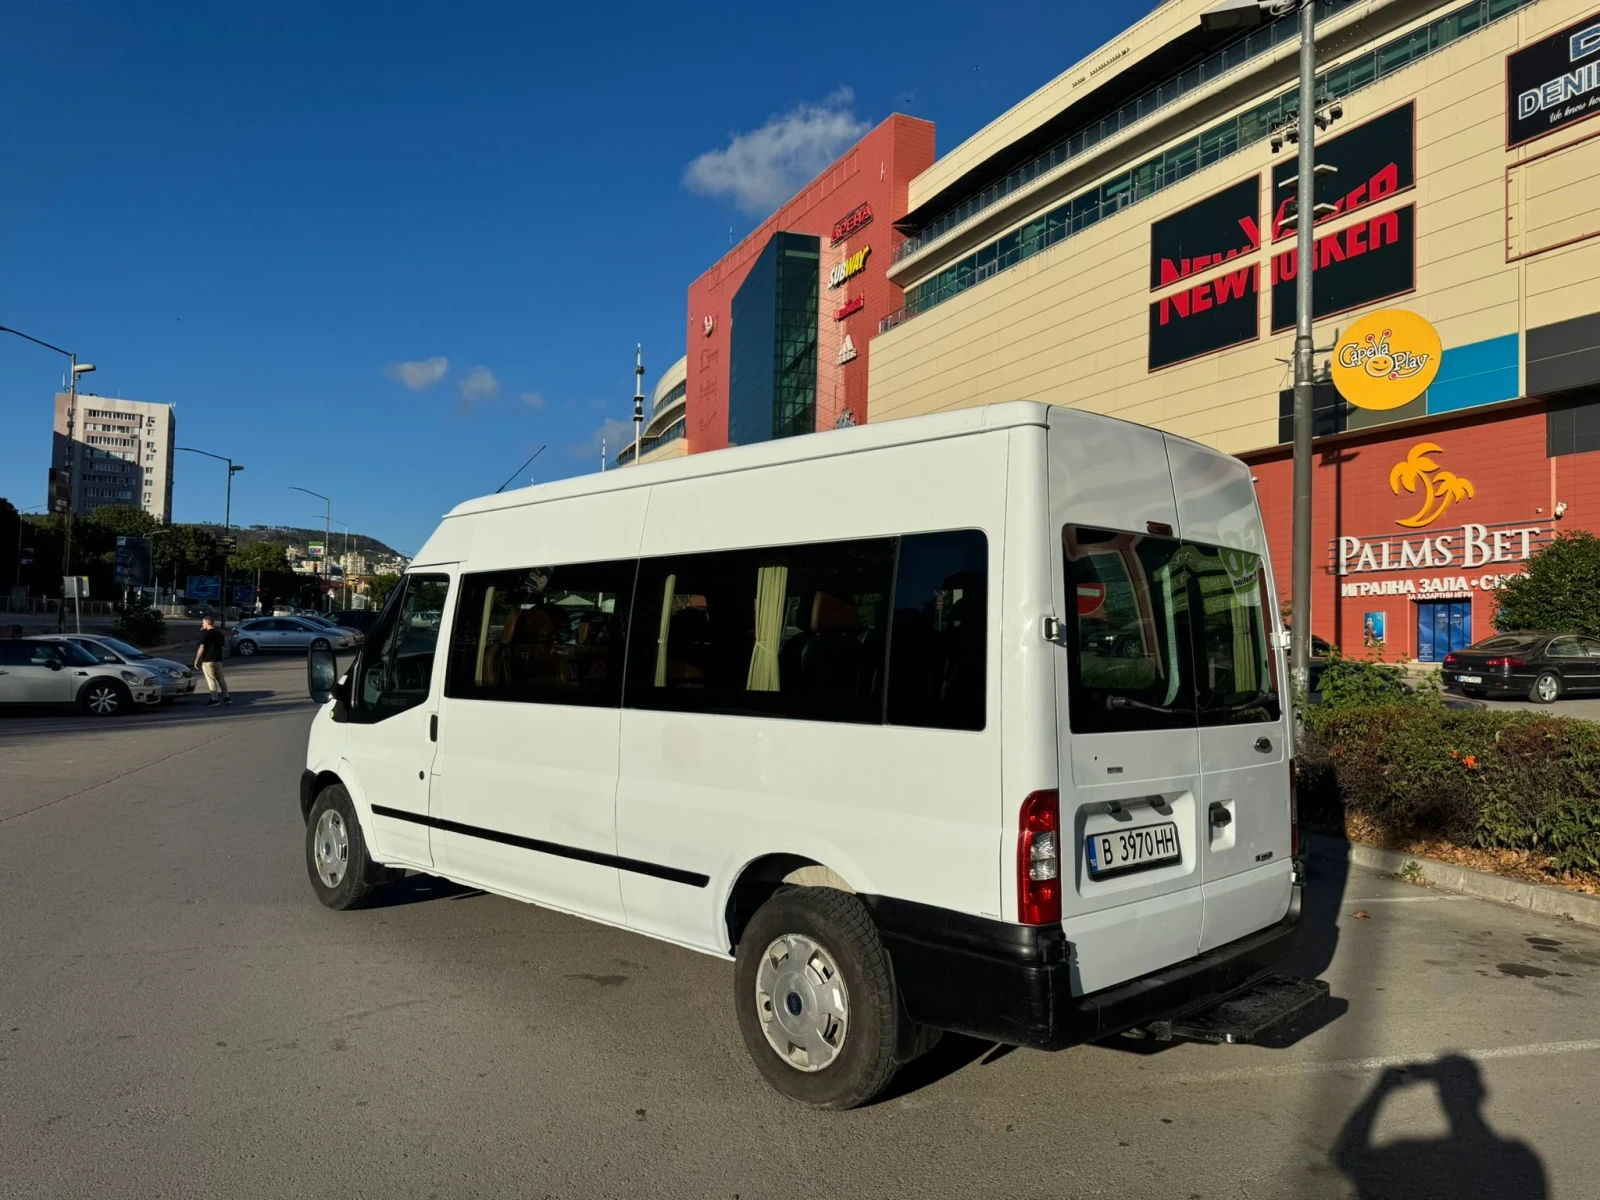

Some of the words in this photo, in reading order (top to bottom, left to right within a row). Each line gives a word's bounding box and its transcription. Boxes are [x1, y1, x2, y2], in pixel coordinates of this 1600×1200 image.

[1549, 108, 1562, 123] We
[1562, 102, 1586, 117] know
[1588, 95, 1600, 107] ho
[828, 245, 870, 289] SUBWAY
[1160, 245, 1251, 326] NEW
[1391, 351, 1429, 379] Play
[1338, 536, 1453, 576] PALMS
[1460, 523, 1540, 568] BET
[1341, 579, 1416, 598] ИГРАЛНА
[1419, 576, 1469, 594] ЗАЛА
[1101, 838, 1113, 865] B
